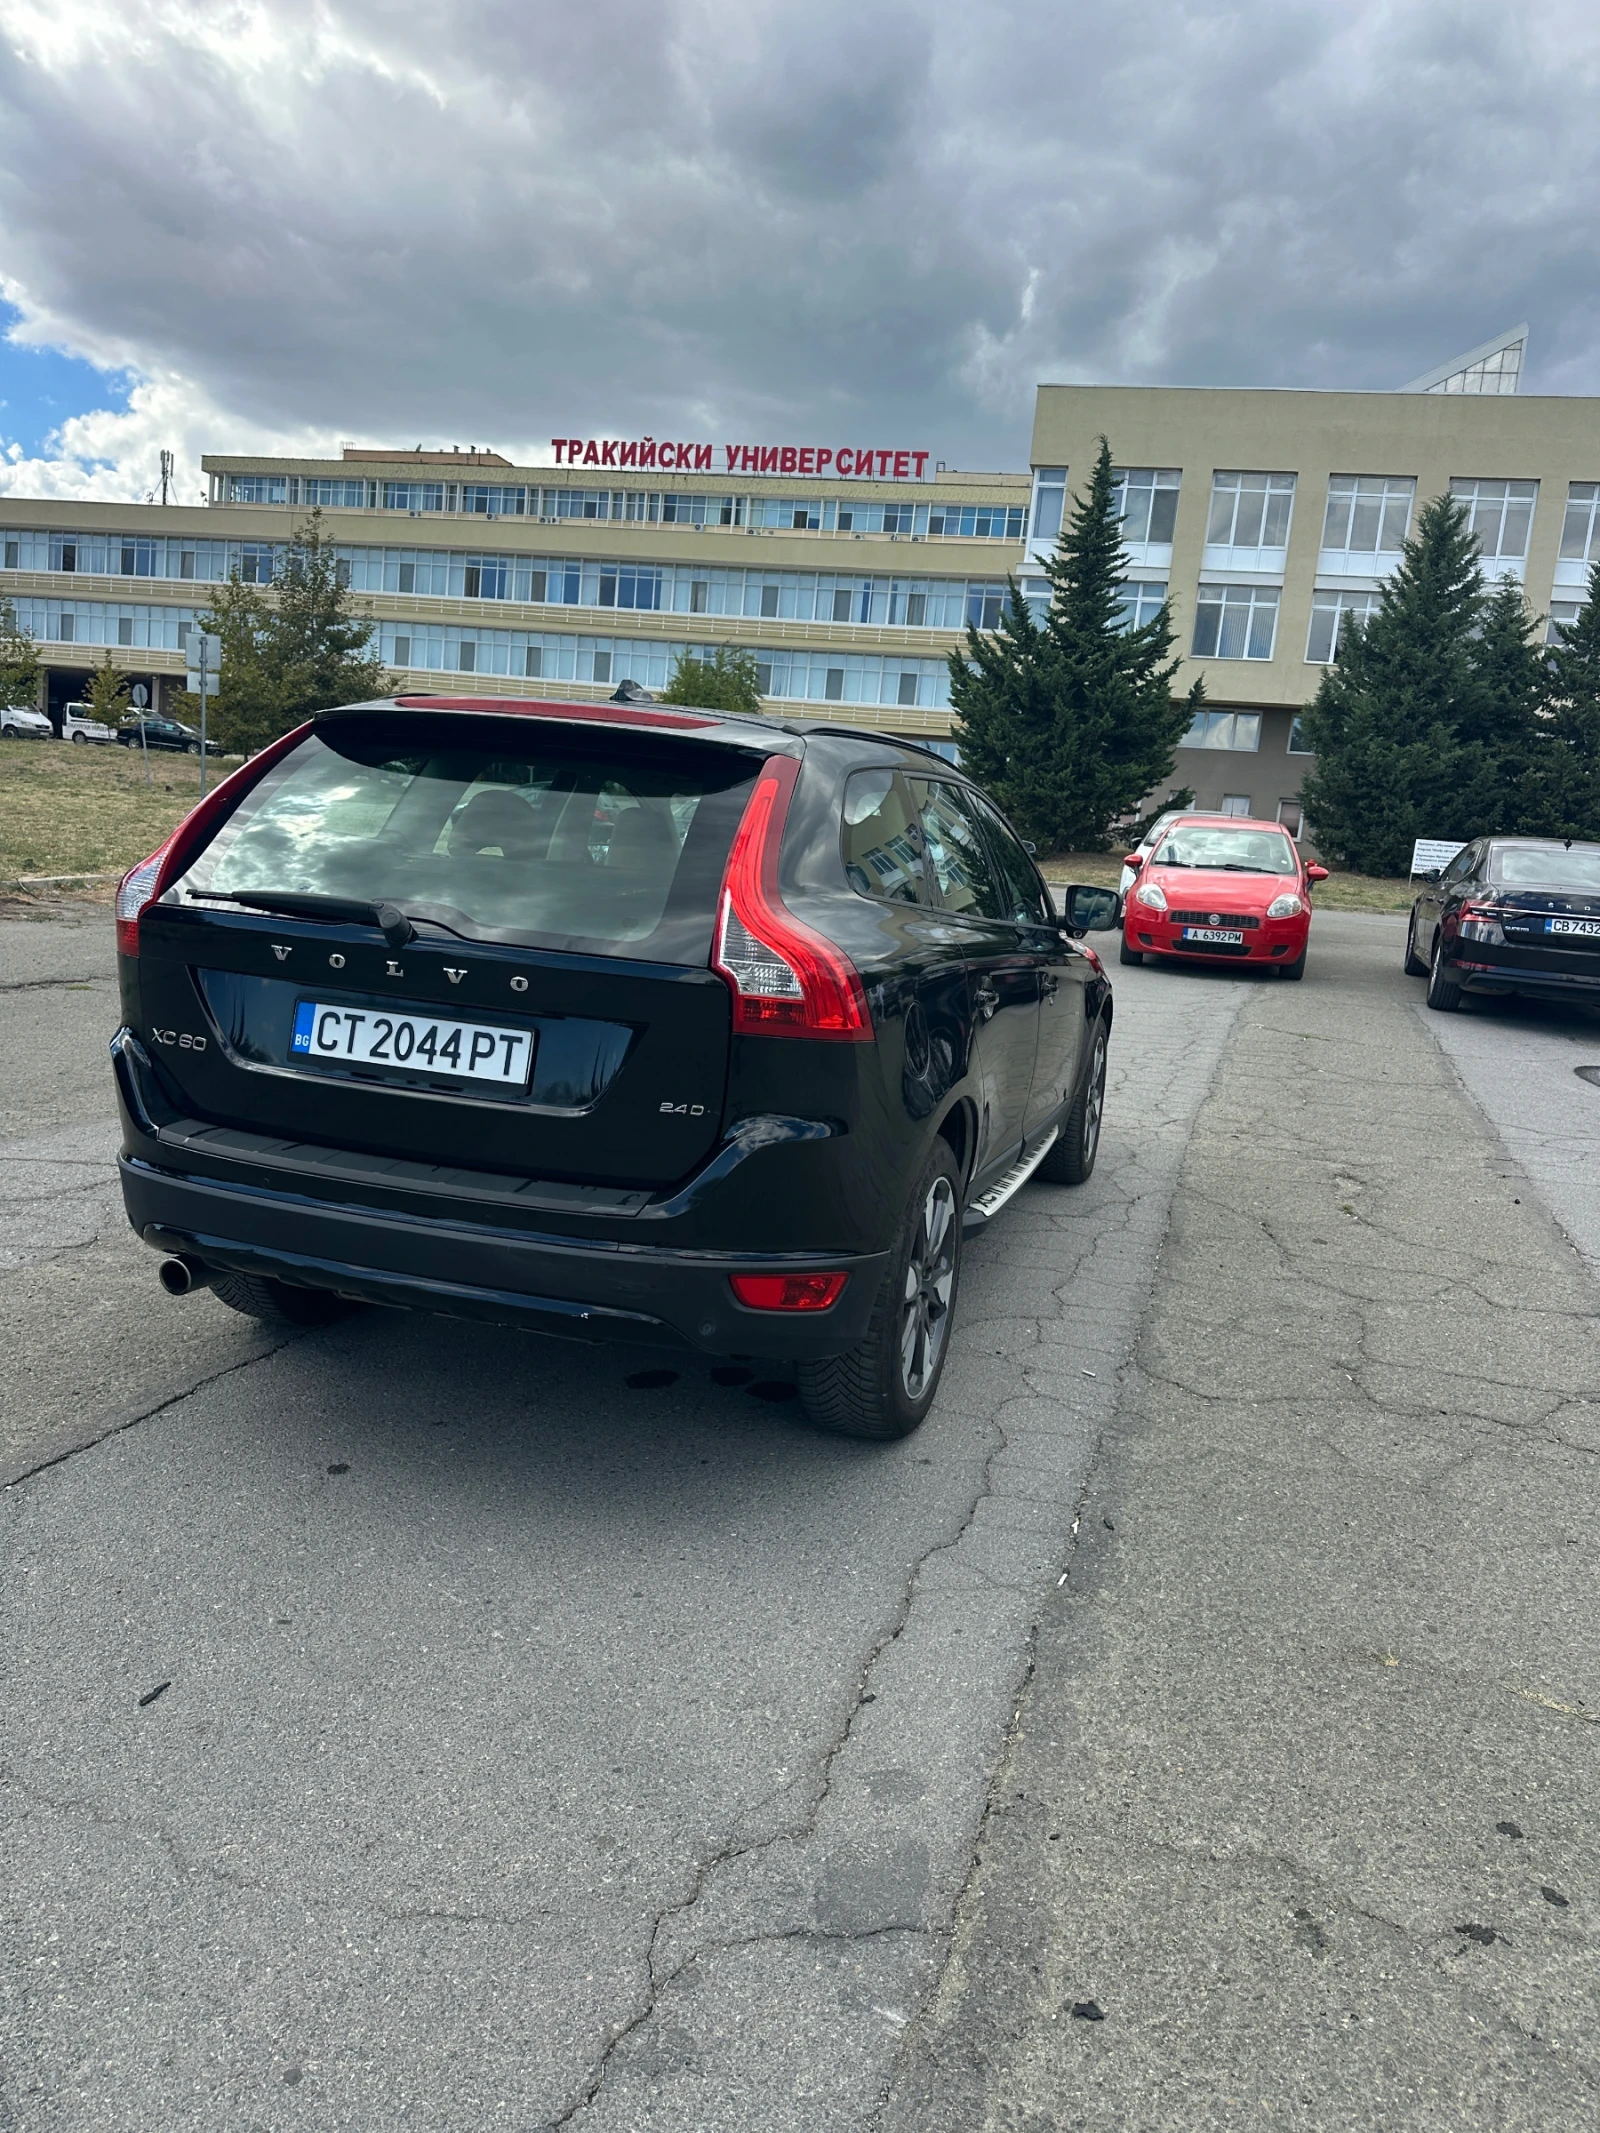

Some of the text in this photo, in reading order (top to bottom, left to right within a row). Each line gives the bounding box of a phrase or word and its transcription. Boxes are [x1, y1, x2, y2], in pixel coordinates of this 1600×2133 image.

[551, 437, 929, 478] ТРАКИЙСКИ УНИВЕРСИТЕТ
[271, 944, 529, 992] VOLVO
[150, 1027, 208, 1052] XC60
[294, 1033, 309, 1047] BG
